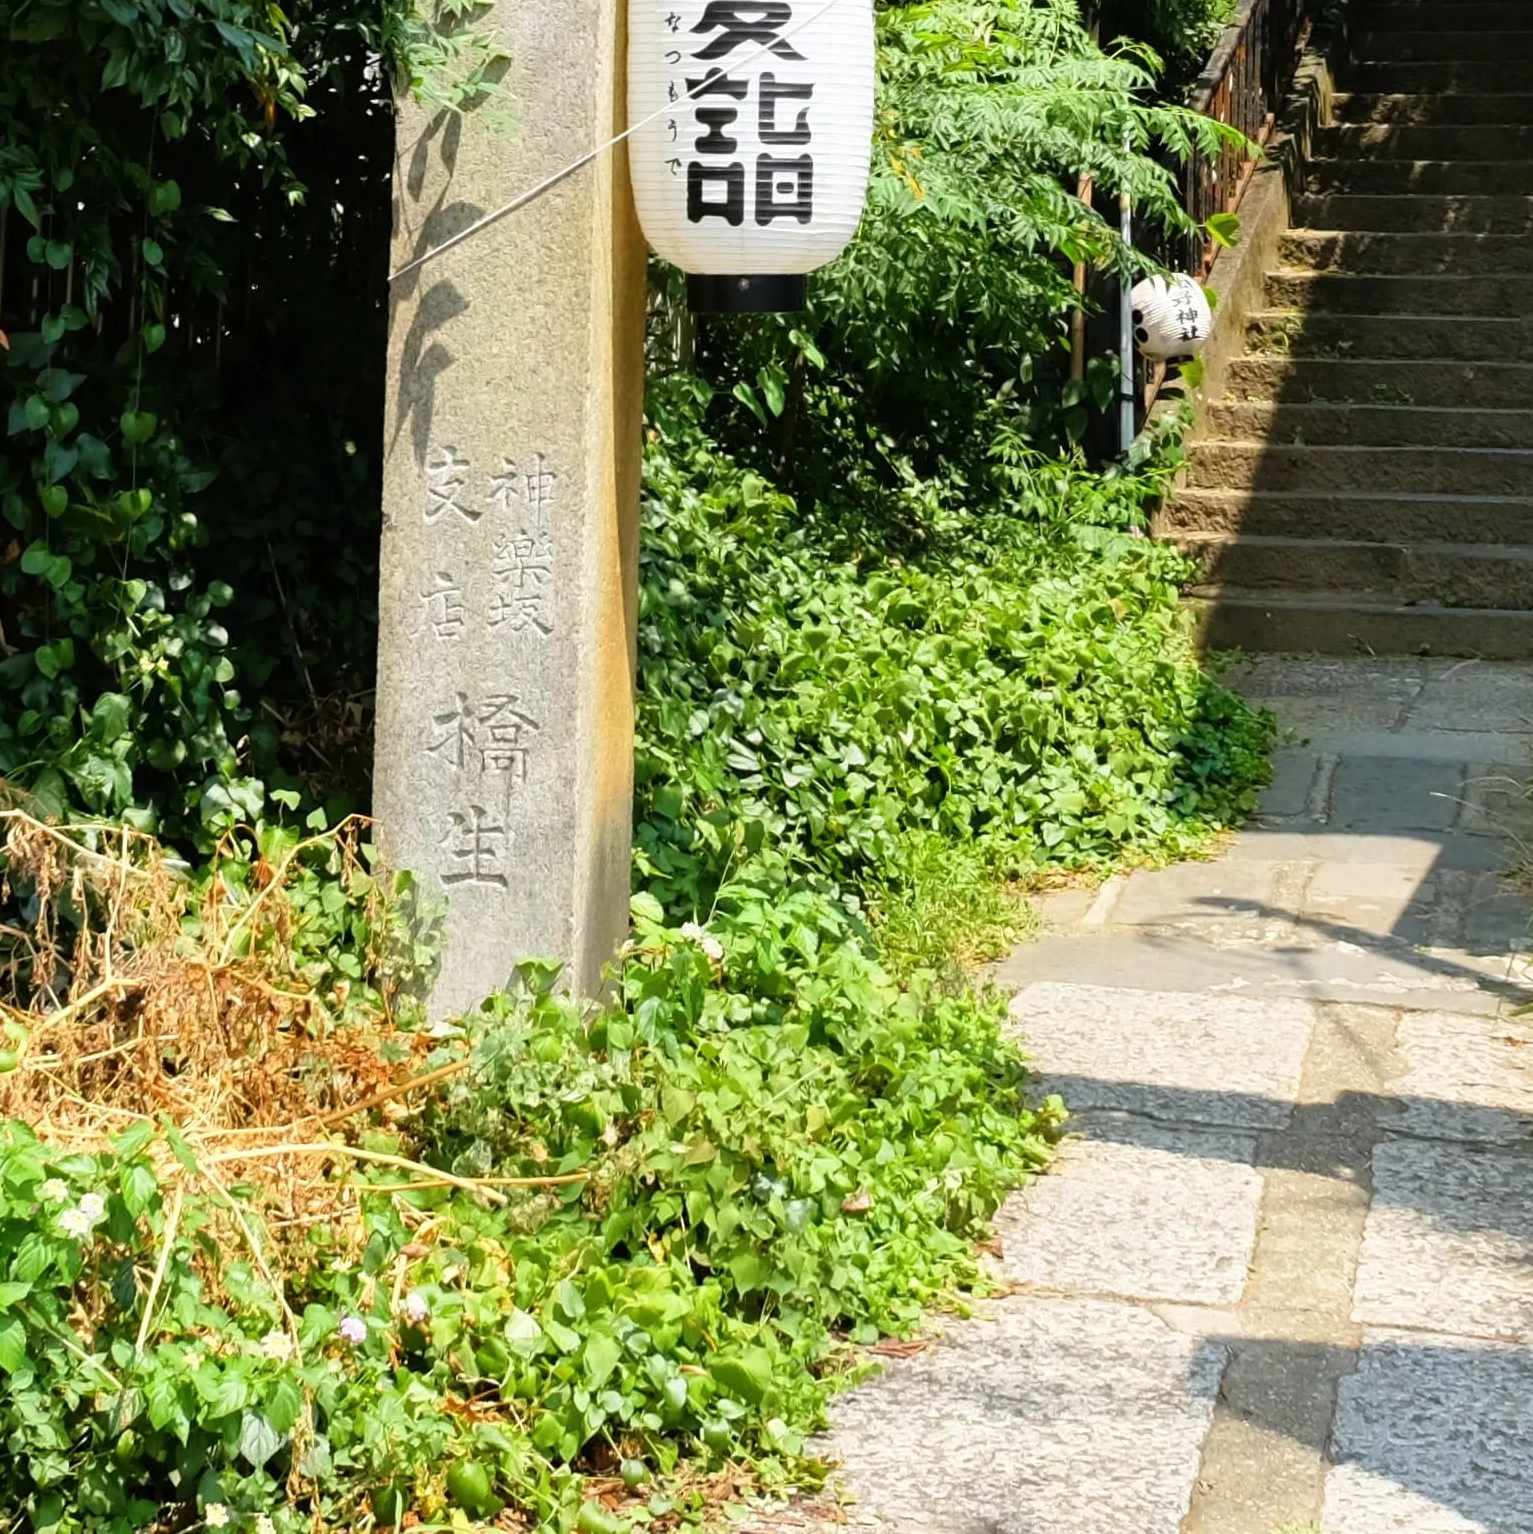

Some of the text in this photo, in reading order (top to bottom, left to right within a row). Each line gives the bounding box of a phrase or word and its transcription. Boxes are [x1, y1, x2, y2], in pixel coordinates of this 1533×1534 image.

[663, 11, 683, 176] なつもうで
